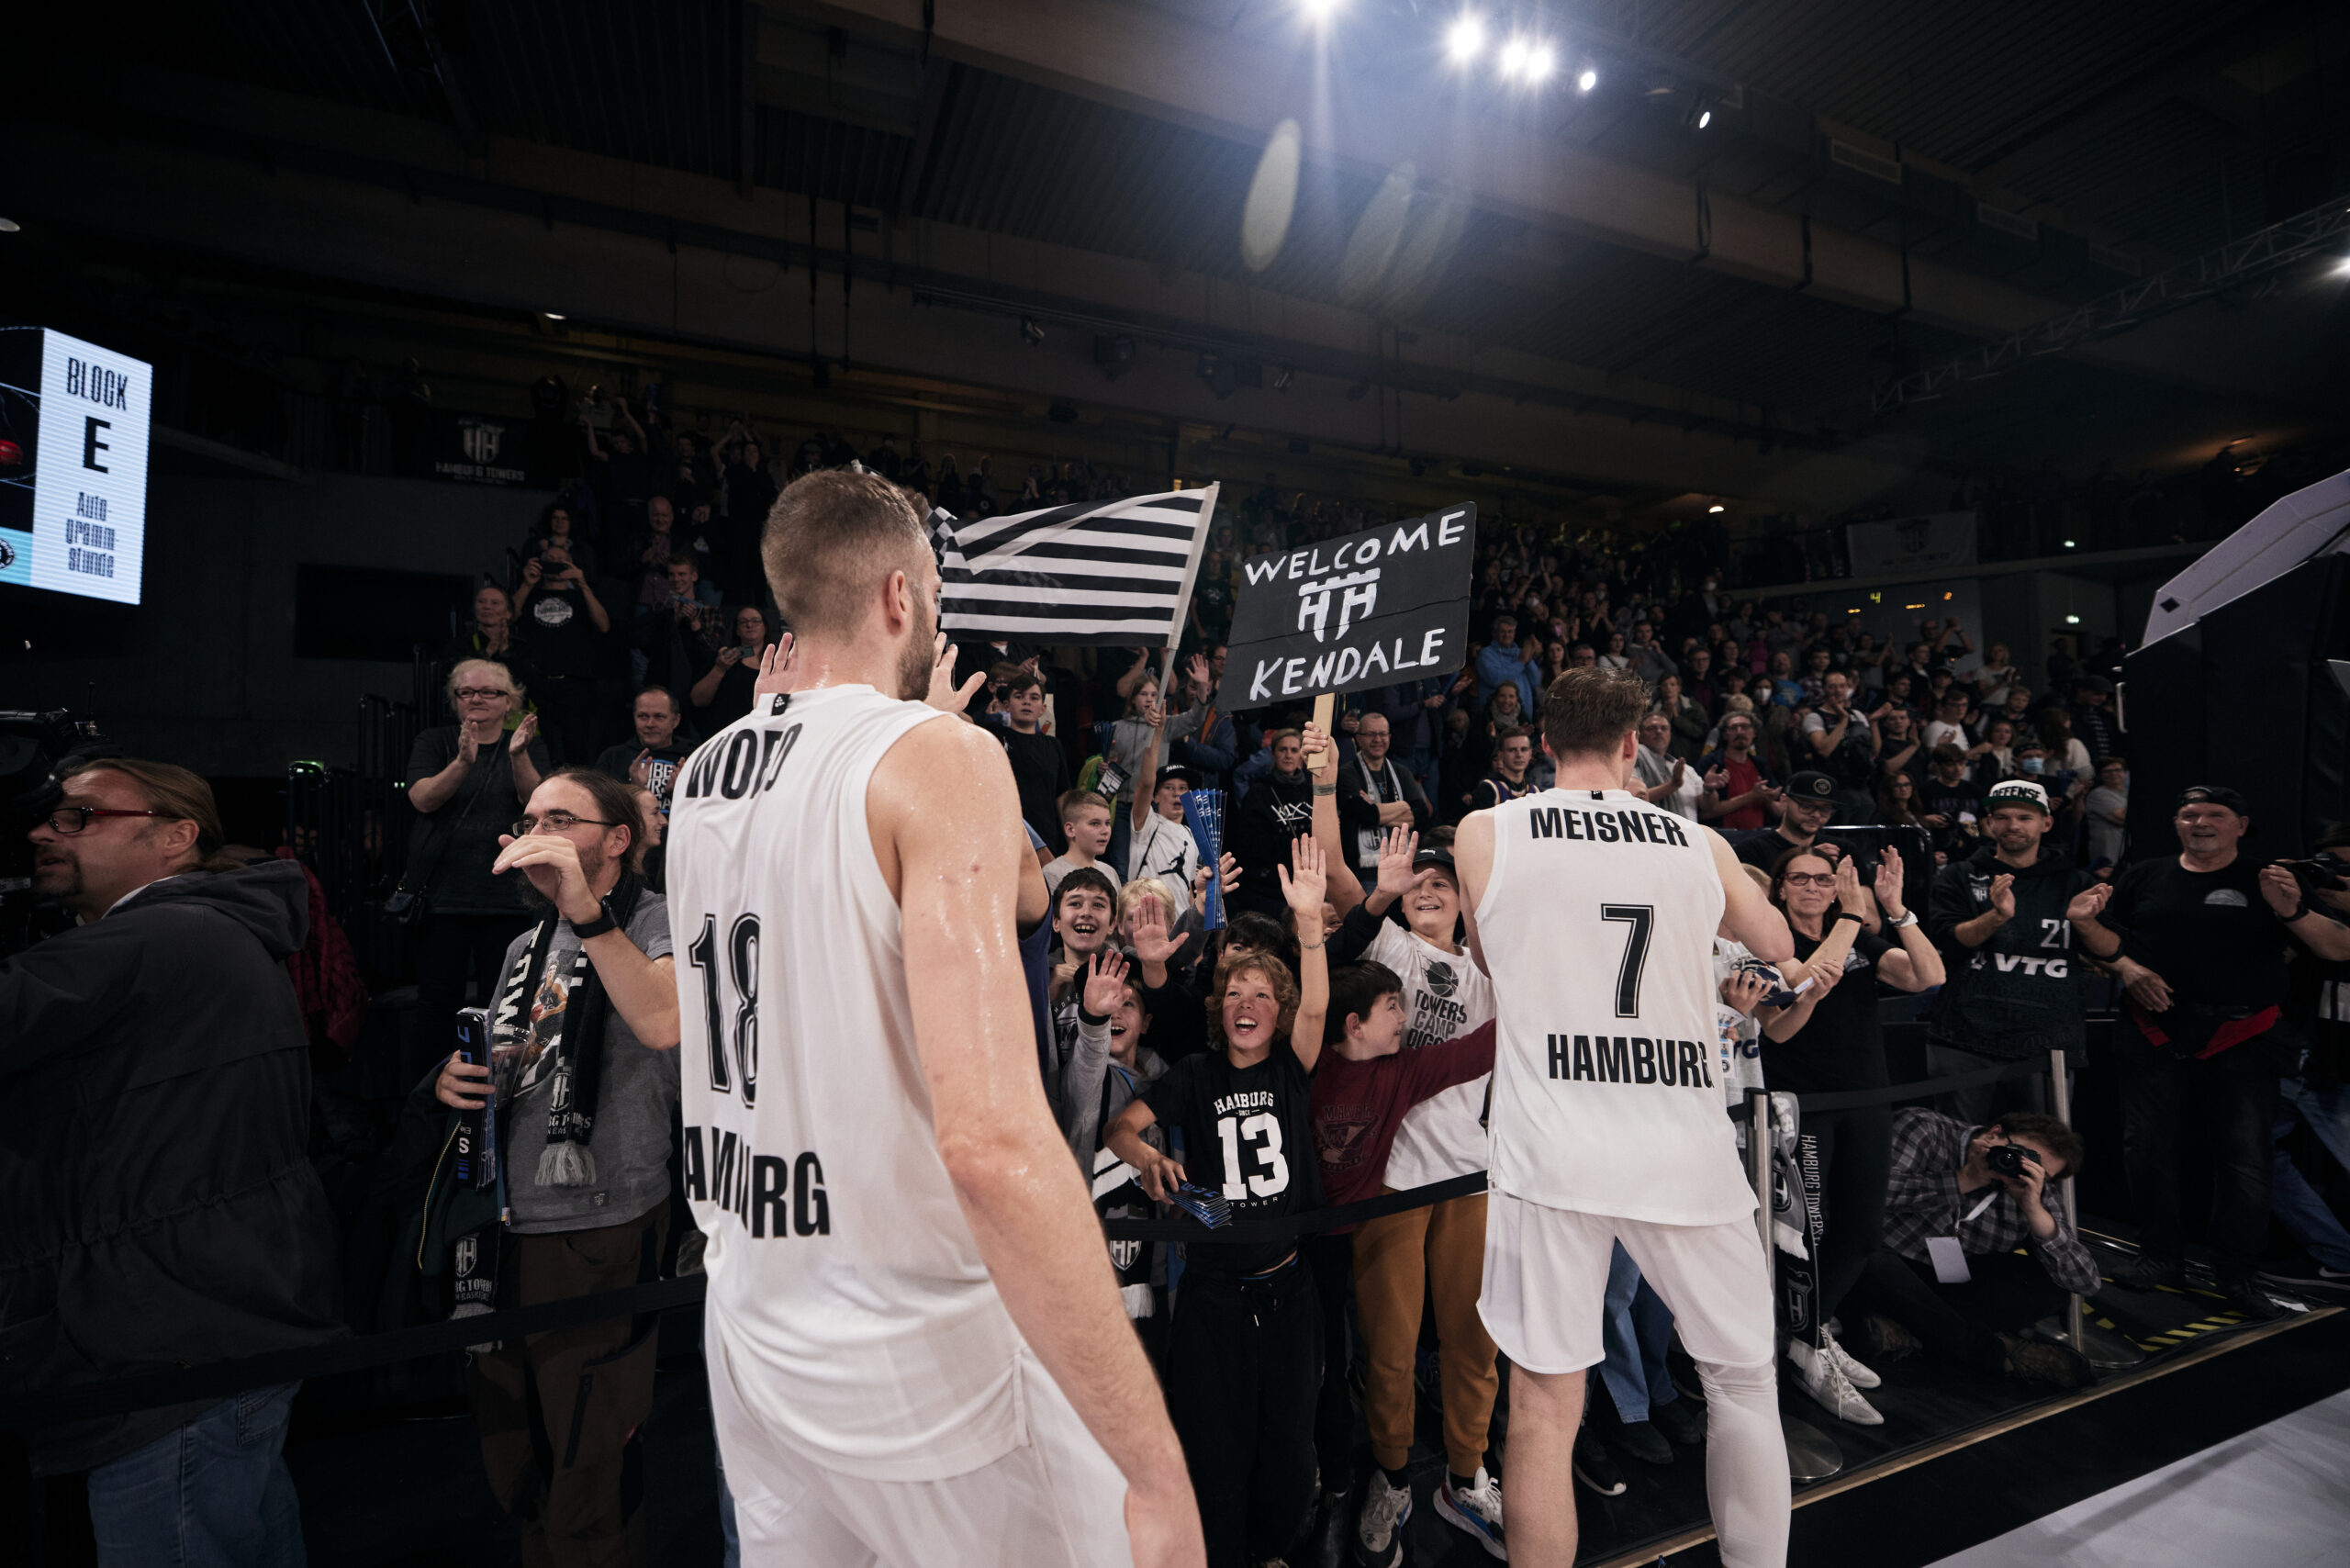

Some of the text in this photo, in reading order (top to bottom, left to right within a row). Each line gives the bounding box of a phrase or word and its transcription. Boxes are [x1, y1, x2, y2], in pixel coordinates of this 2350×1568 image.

[67, 357, 129, 411] BLOCK
[83, 415, 111, 474] E
[68, 547, 114, 578] stunde
[1245, 510, 1466, 587] WELCOME
[1249, 628, 1446, 701] KENDALE
[1993, 786, 2041, 800] DEFENSE
[1530, 807, 1689, 847] MEISNER
[1601, 902, 1654, 1019] 7
[2040, 919, 2071, 949] 21
[1994, 952, 2069, 979] VTG
[688, 913, 761, 1110] 18
[1414, 1011, 1457, 1039] CAMP
[1415, 989, 1468, 1025] TOWERS
[1217, 1112, 1290, 1201] 13
[1800, 1134, 1819, 1190] HAMBURG
